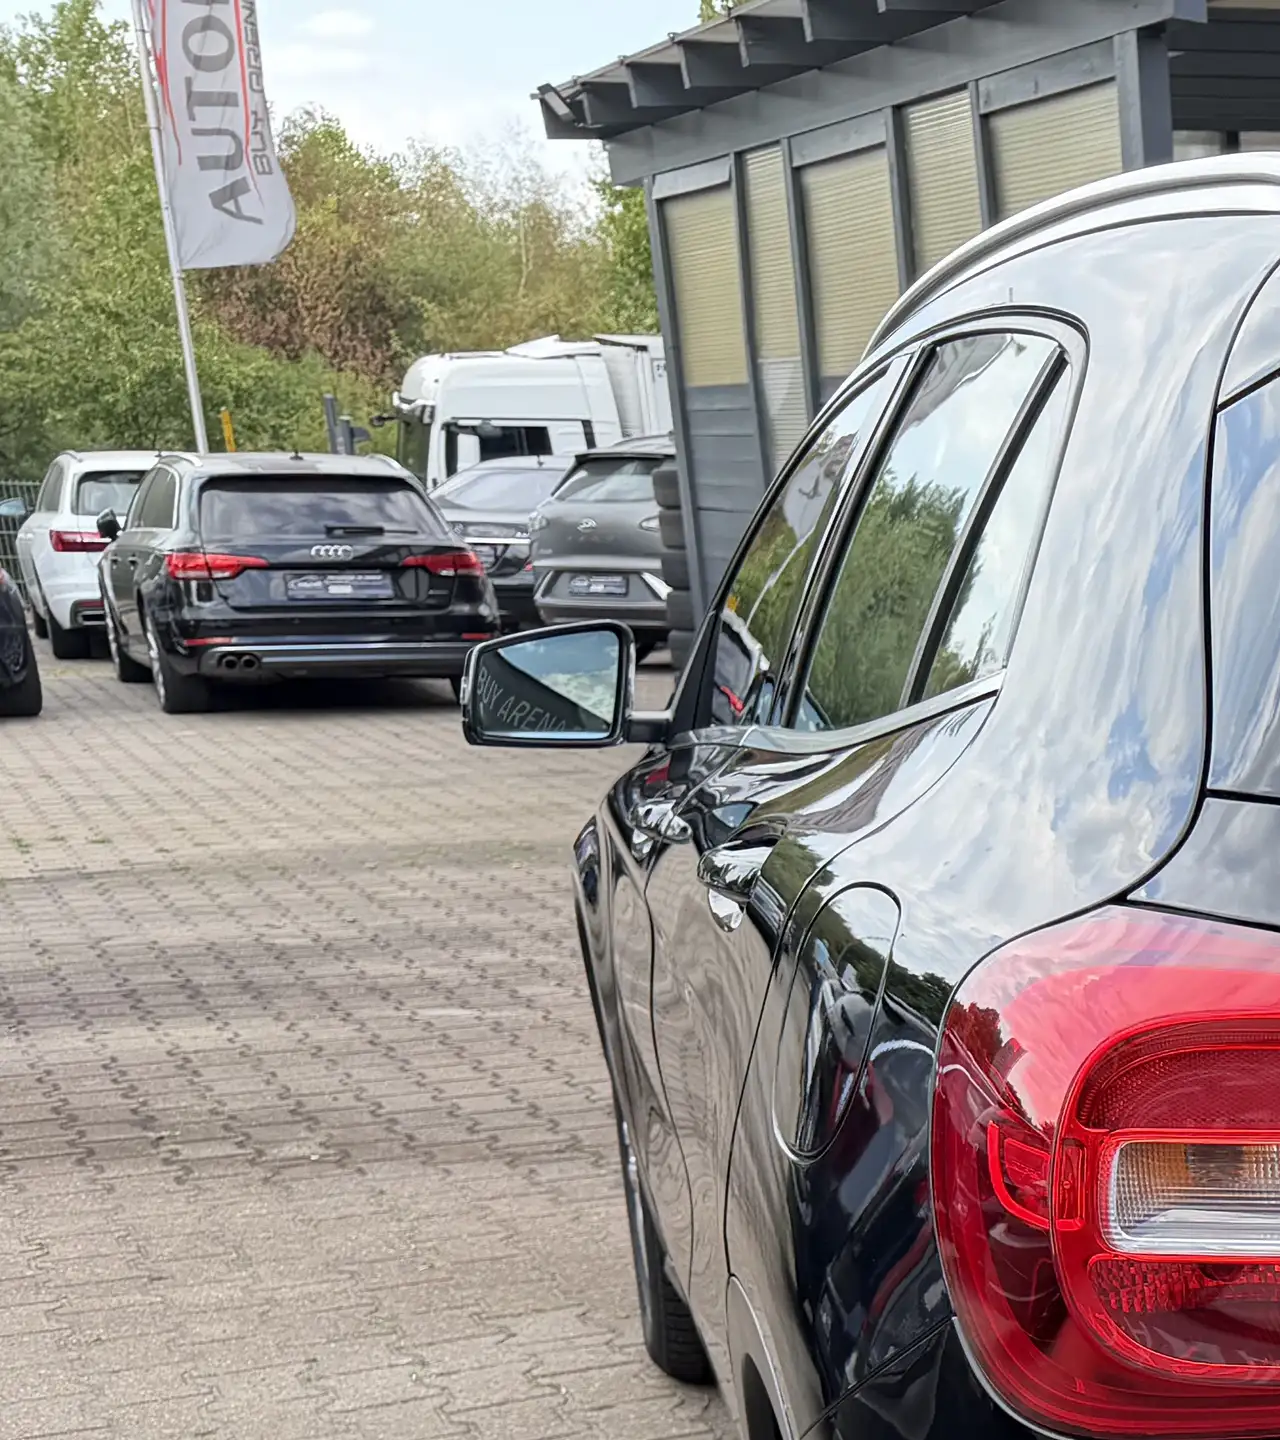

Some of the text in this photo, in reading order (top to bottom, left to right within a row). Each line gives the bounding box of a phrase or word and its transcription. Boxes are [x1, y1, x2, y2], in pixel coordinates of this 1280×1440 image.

[181, 0, 264, 225] AUTO
[242, 0, 273, 175] BUY AREN
[477, 666, 504, 710] BUY
